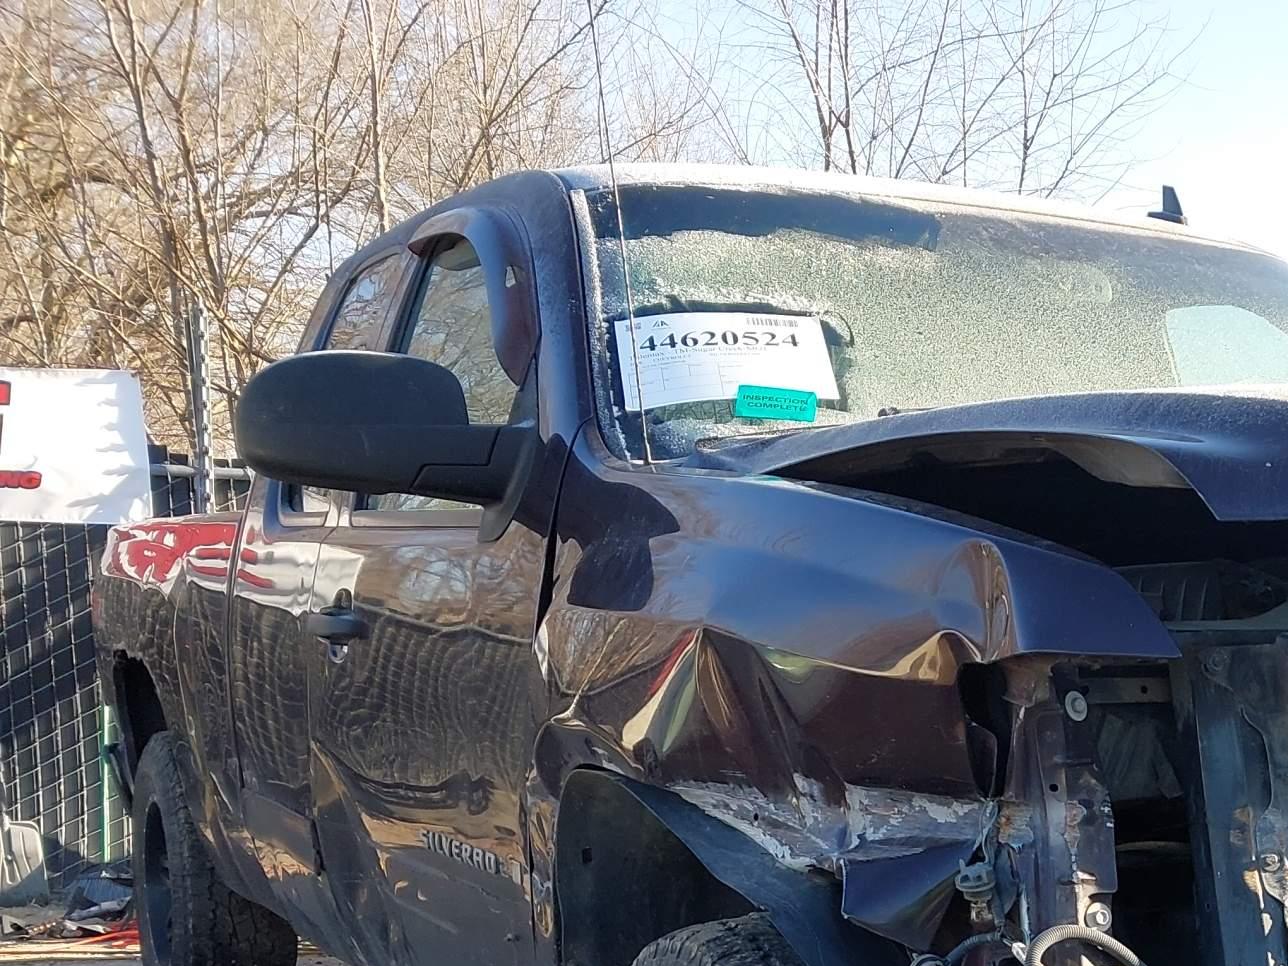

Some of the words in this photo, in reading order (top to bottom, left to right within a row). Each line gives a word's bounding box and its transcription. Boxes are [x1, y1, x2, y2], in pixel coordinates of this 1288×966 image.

[639, 330, 800, 352] 44620524
[743, 394, 808, 405] INSPECTION
[747, 402, 808, 412] COMPLETE
